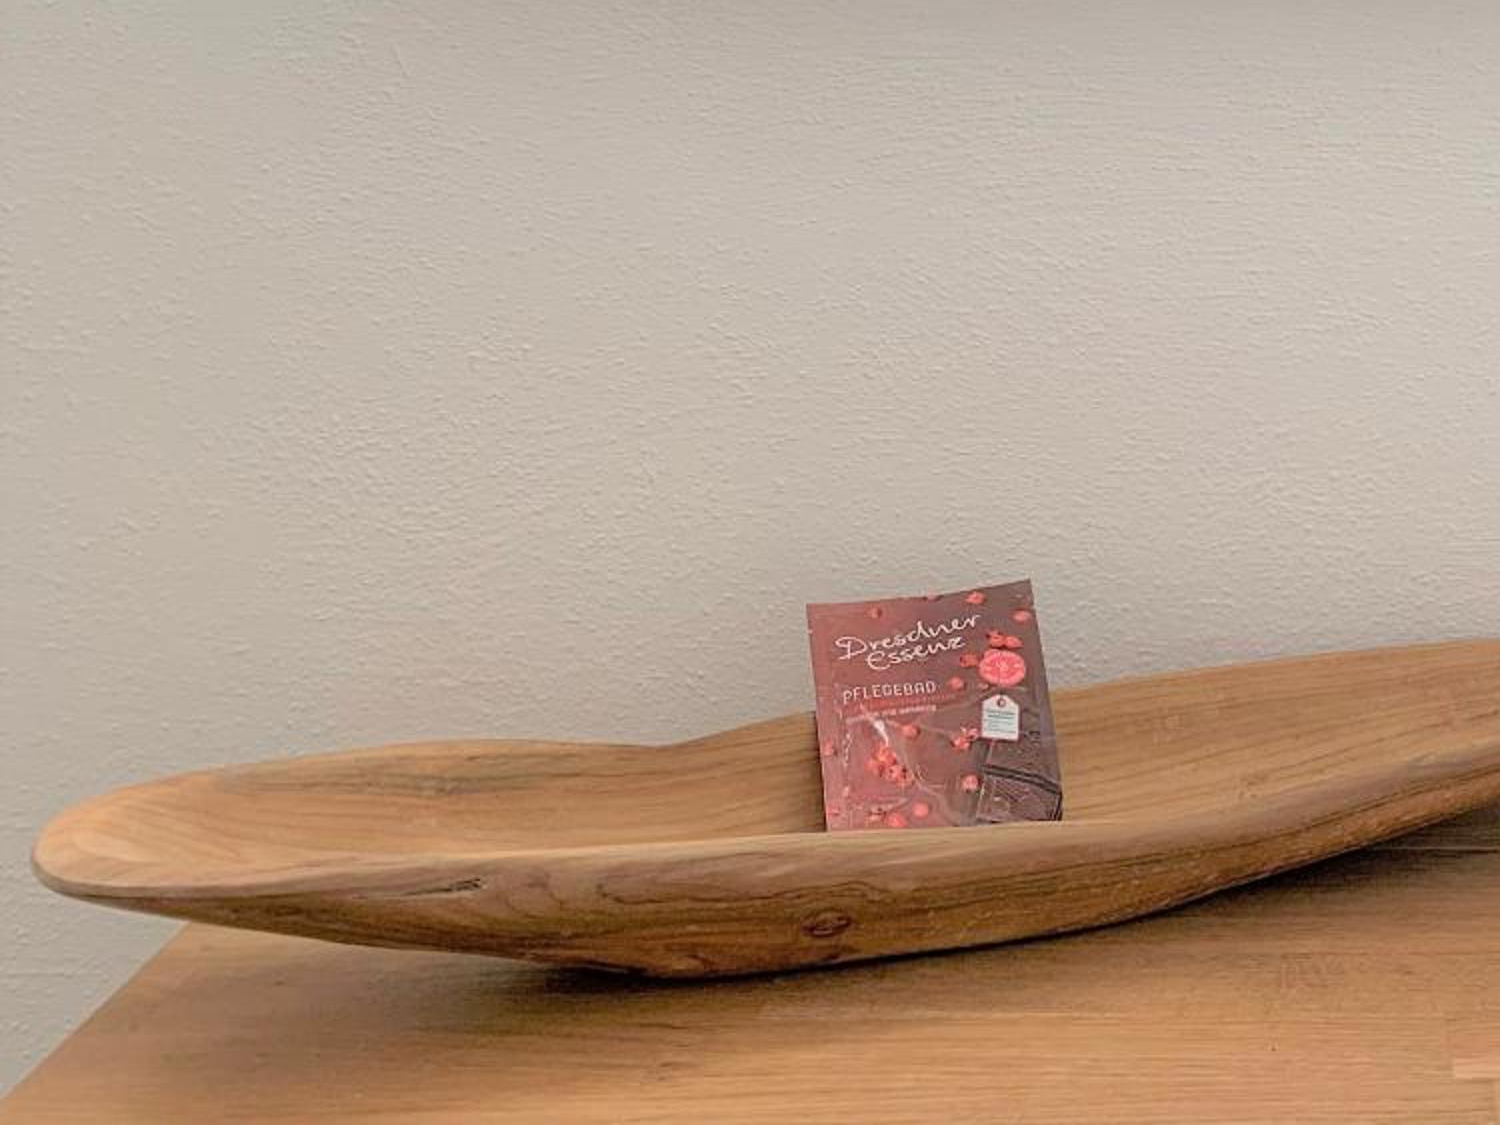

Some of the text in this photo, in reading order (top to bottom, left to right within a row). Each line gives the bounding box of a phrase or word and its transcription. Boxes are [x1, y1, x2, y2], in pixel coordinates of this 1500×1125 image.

[835, 614, 981, 660] Dresdner
[866, 636, 966, 671] Essenz
[843, 681, 937, 704] PFLEGEBAD
